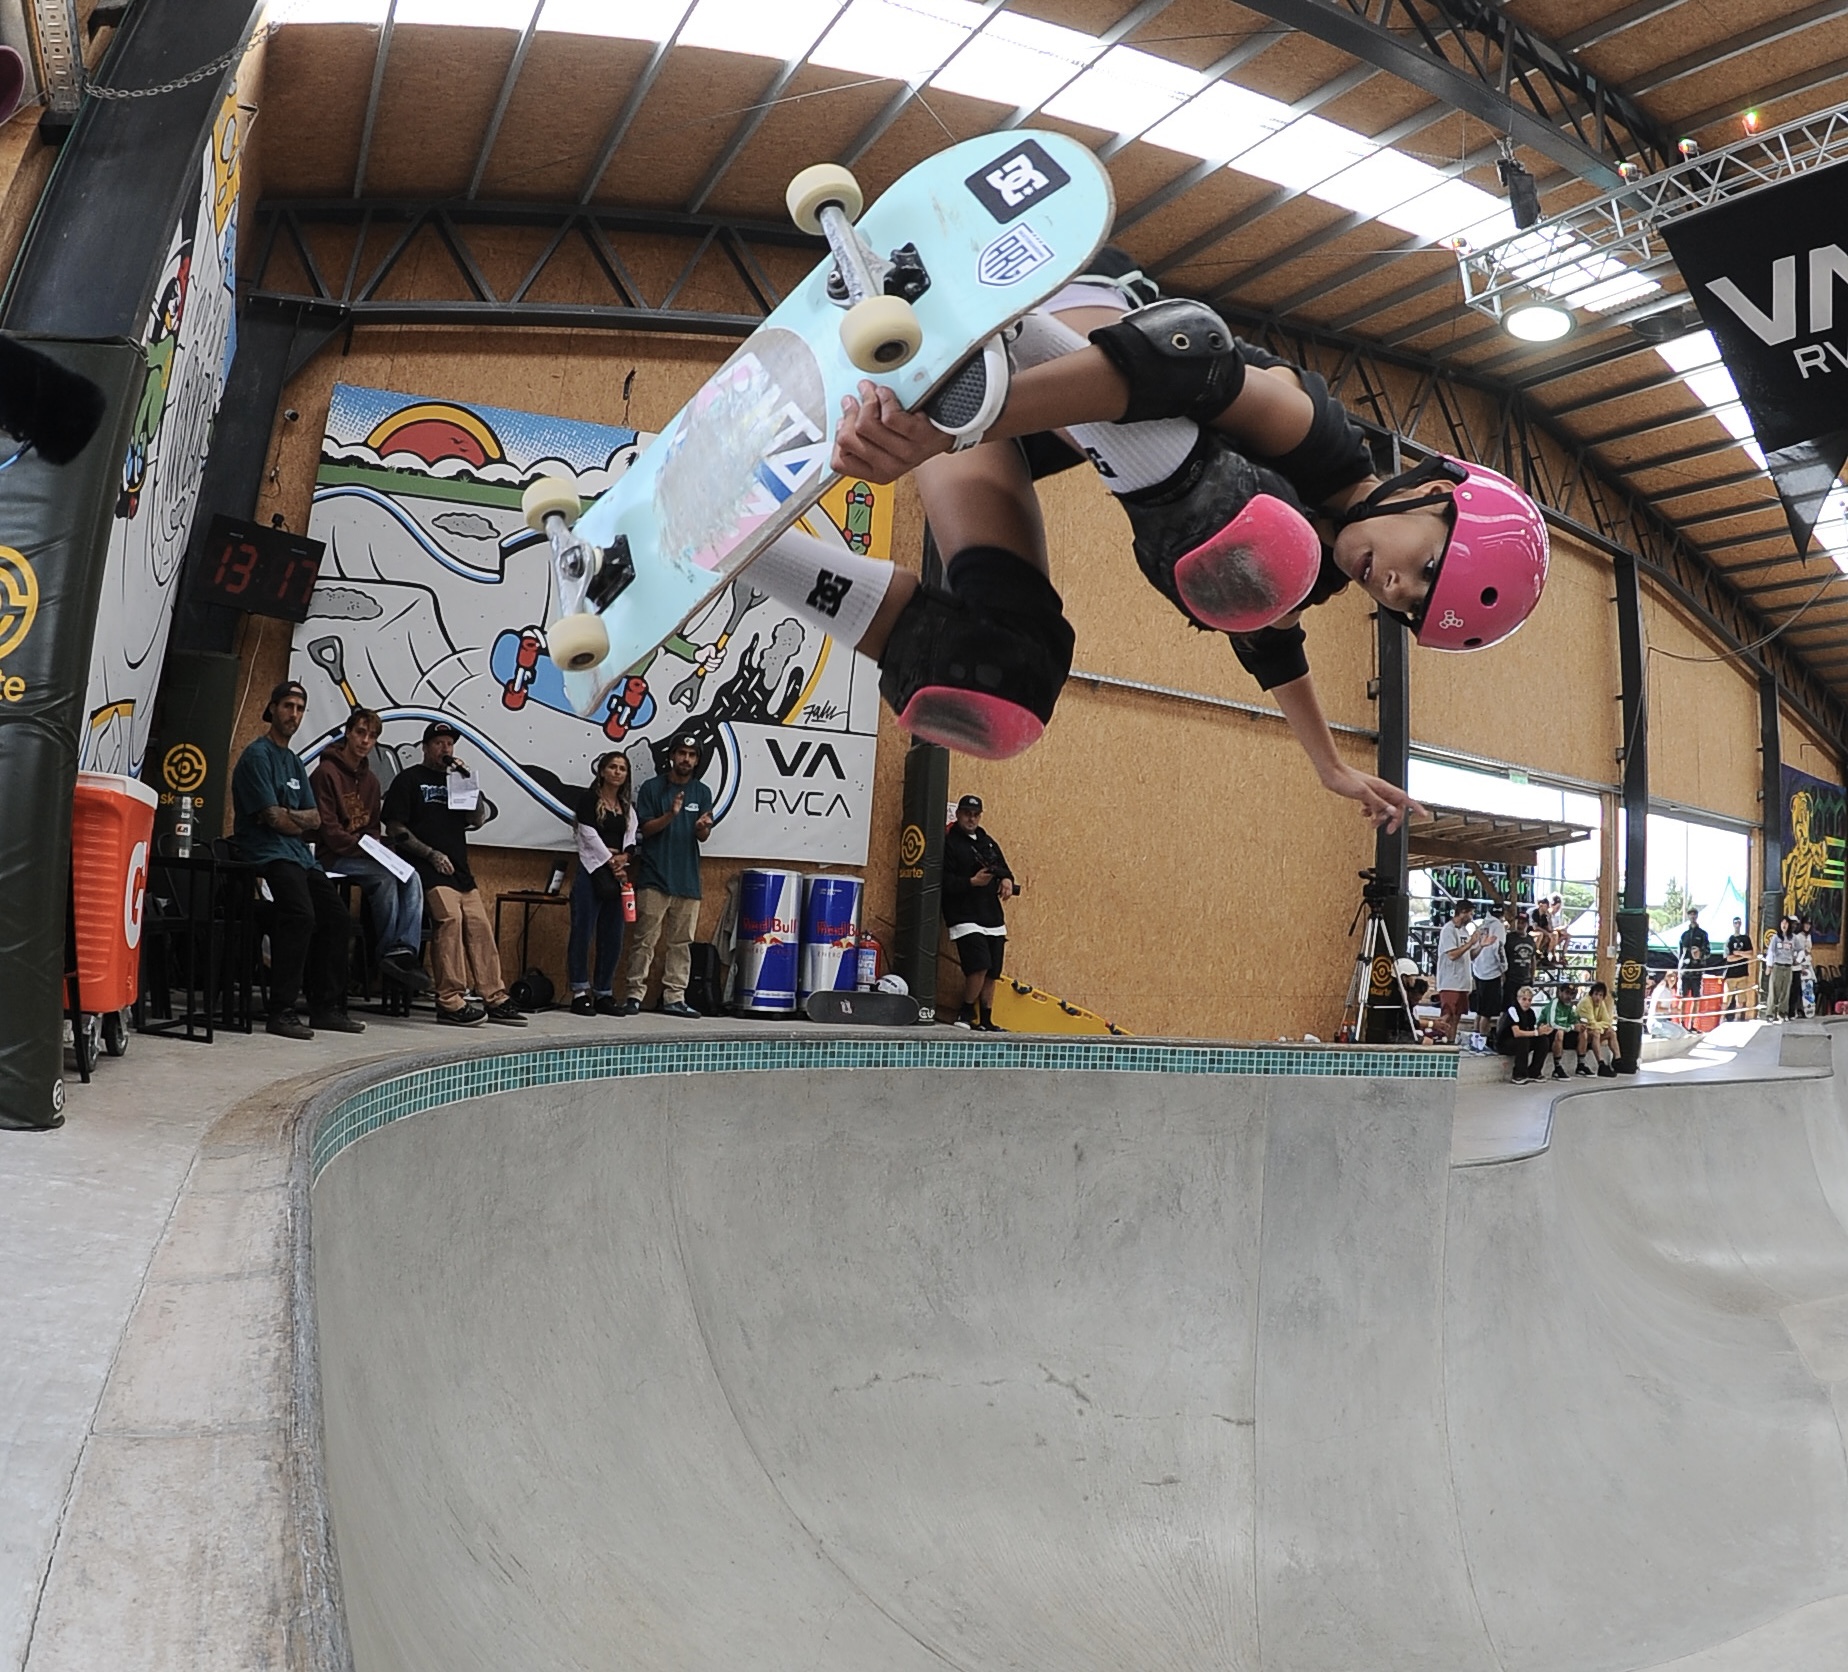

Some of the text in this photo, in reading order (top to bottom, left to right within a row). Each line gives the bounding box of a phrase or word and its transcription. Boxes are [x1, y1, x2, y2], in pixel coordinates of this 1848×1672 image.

[755, 788, 851, 818] RVCA
[772, 918, 797, 933] Bull
[816, 921, 860, 937] Red Bu
